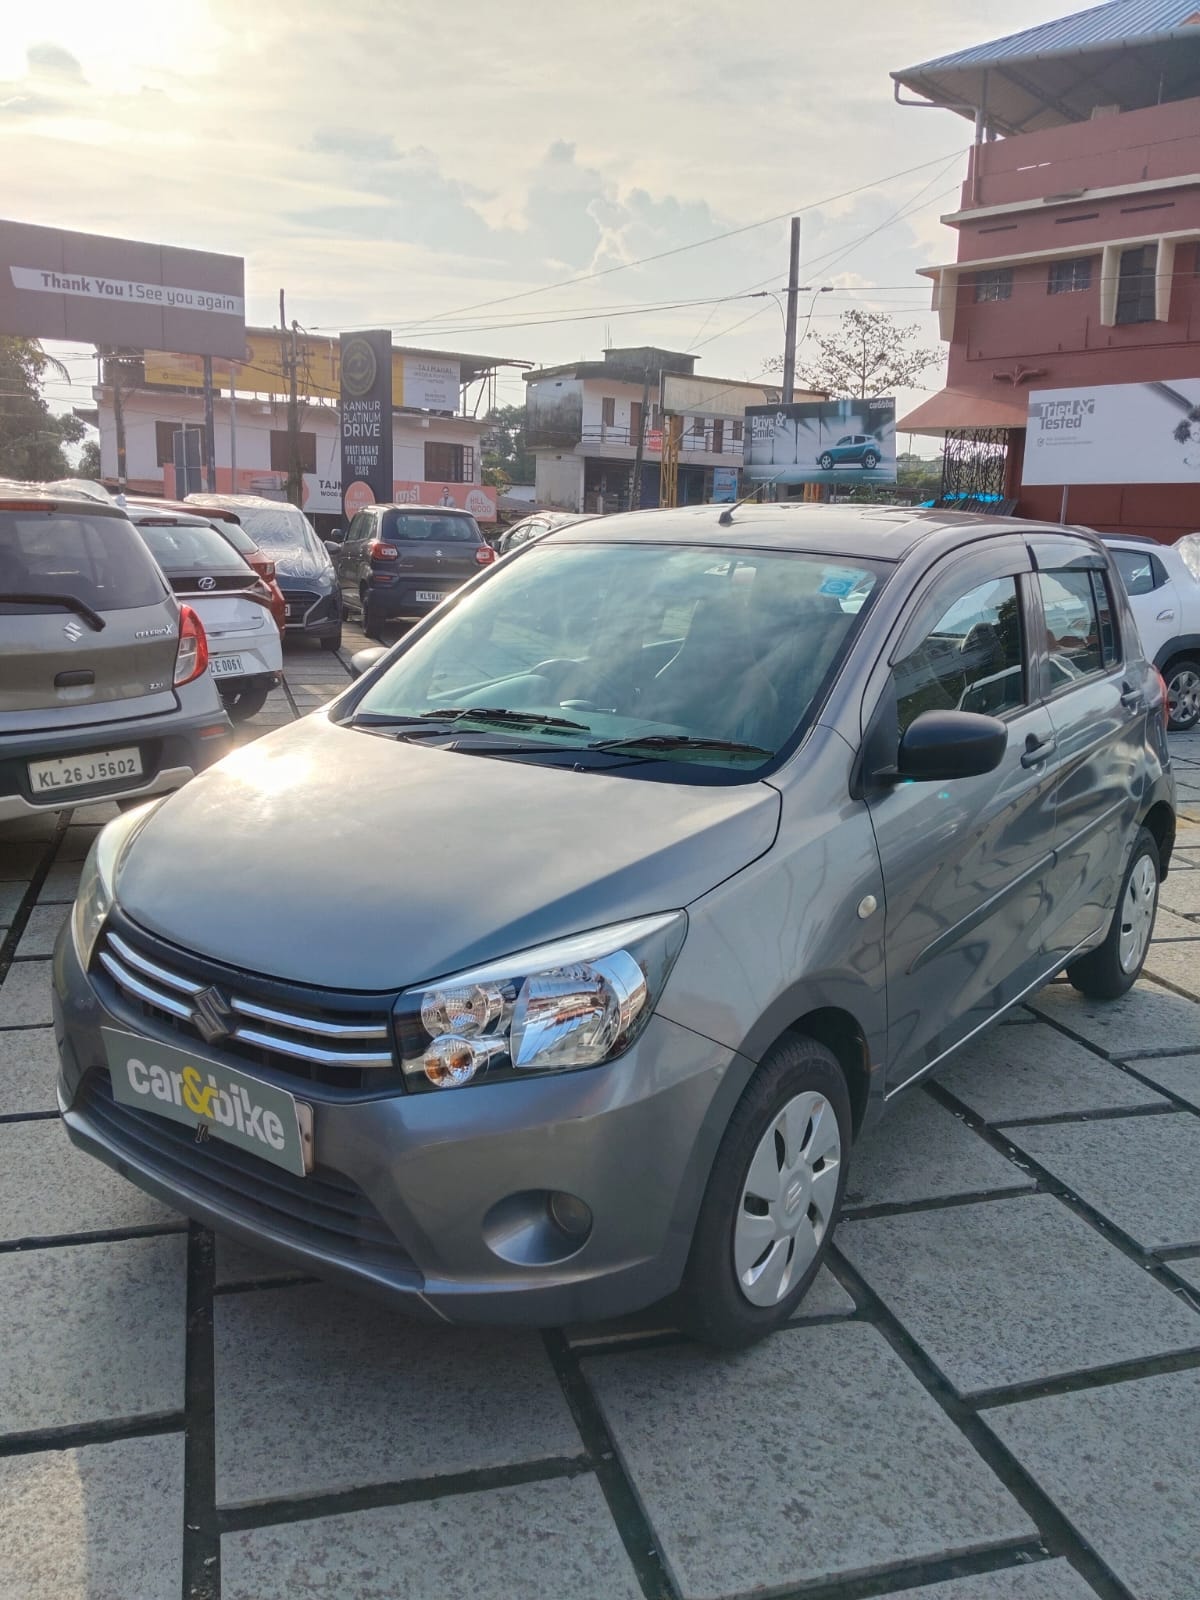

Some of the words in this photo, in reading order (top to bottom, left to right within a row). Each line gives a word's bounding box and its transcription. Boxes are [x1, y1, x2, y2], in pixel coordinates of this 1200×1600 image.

[41, 272, 90, 293] Thank
[95, 280, 124, 297] You
[136, 285, 162, 301] See
[167, 291, 193, 306] you
[197, 296, 235, 311] again
[343, 400, 380, 411] KANNUR
[1040, 401, 1074, 418] Tried
[1077, 398, 1096, 415] &
[343, 411, 381, 423] PLATINUM
[752, 416, 774, 429] Drive
[776, 411, 787, 427] &
[1039, 414, 1083, 430] Tested
[343, 423, 380, 437] DRIVE
[752, 427, 775, 440] Smile
[126, 1058, 285, 1150] car&bike
